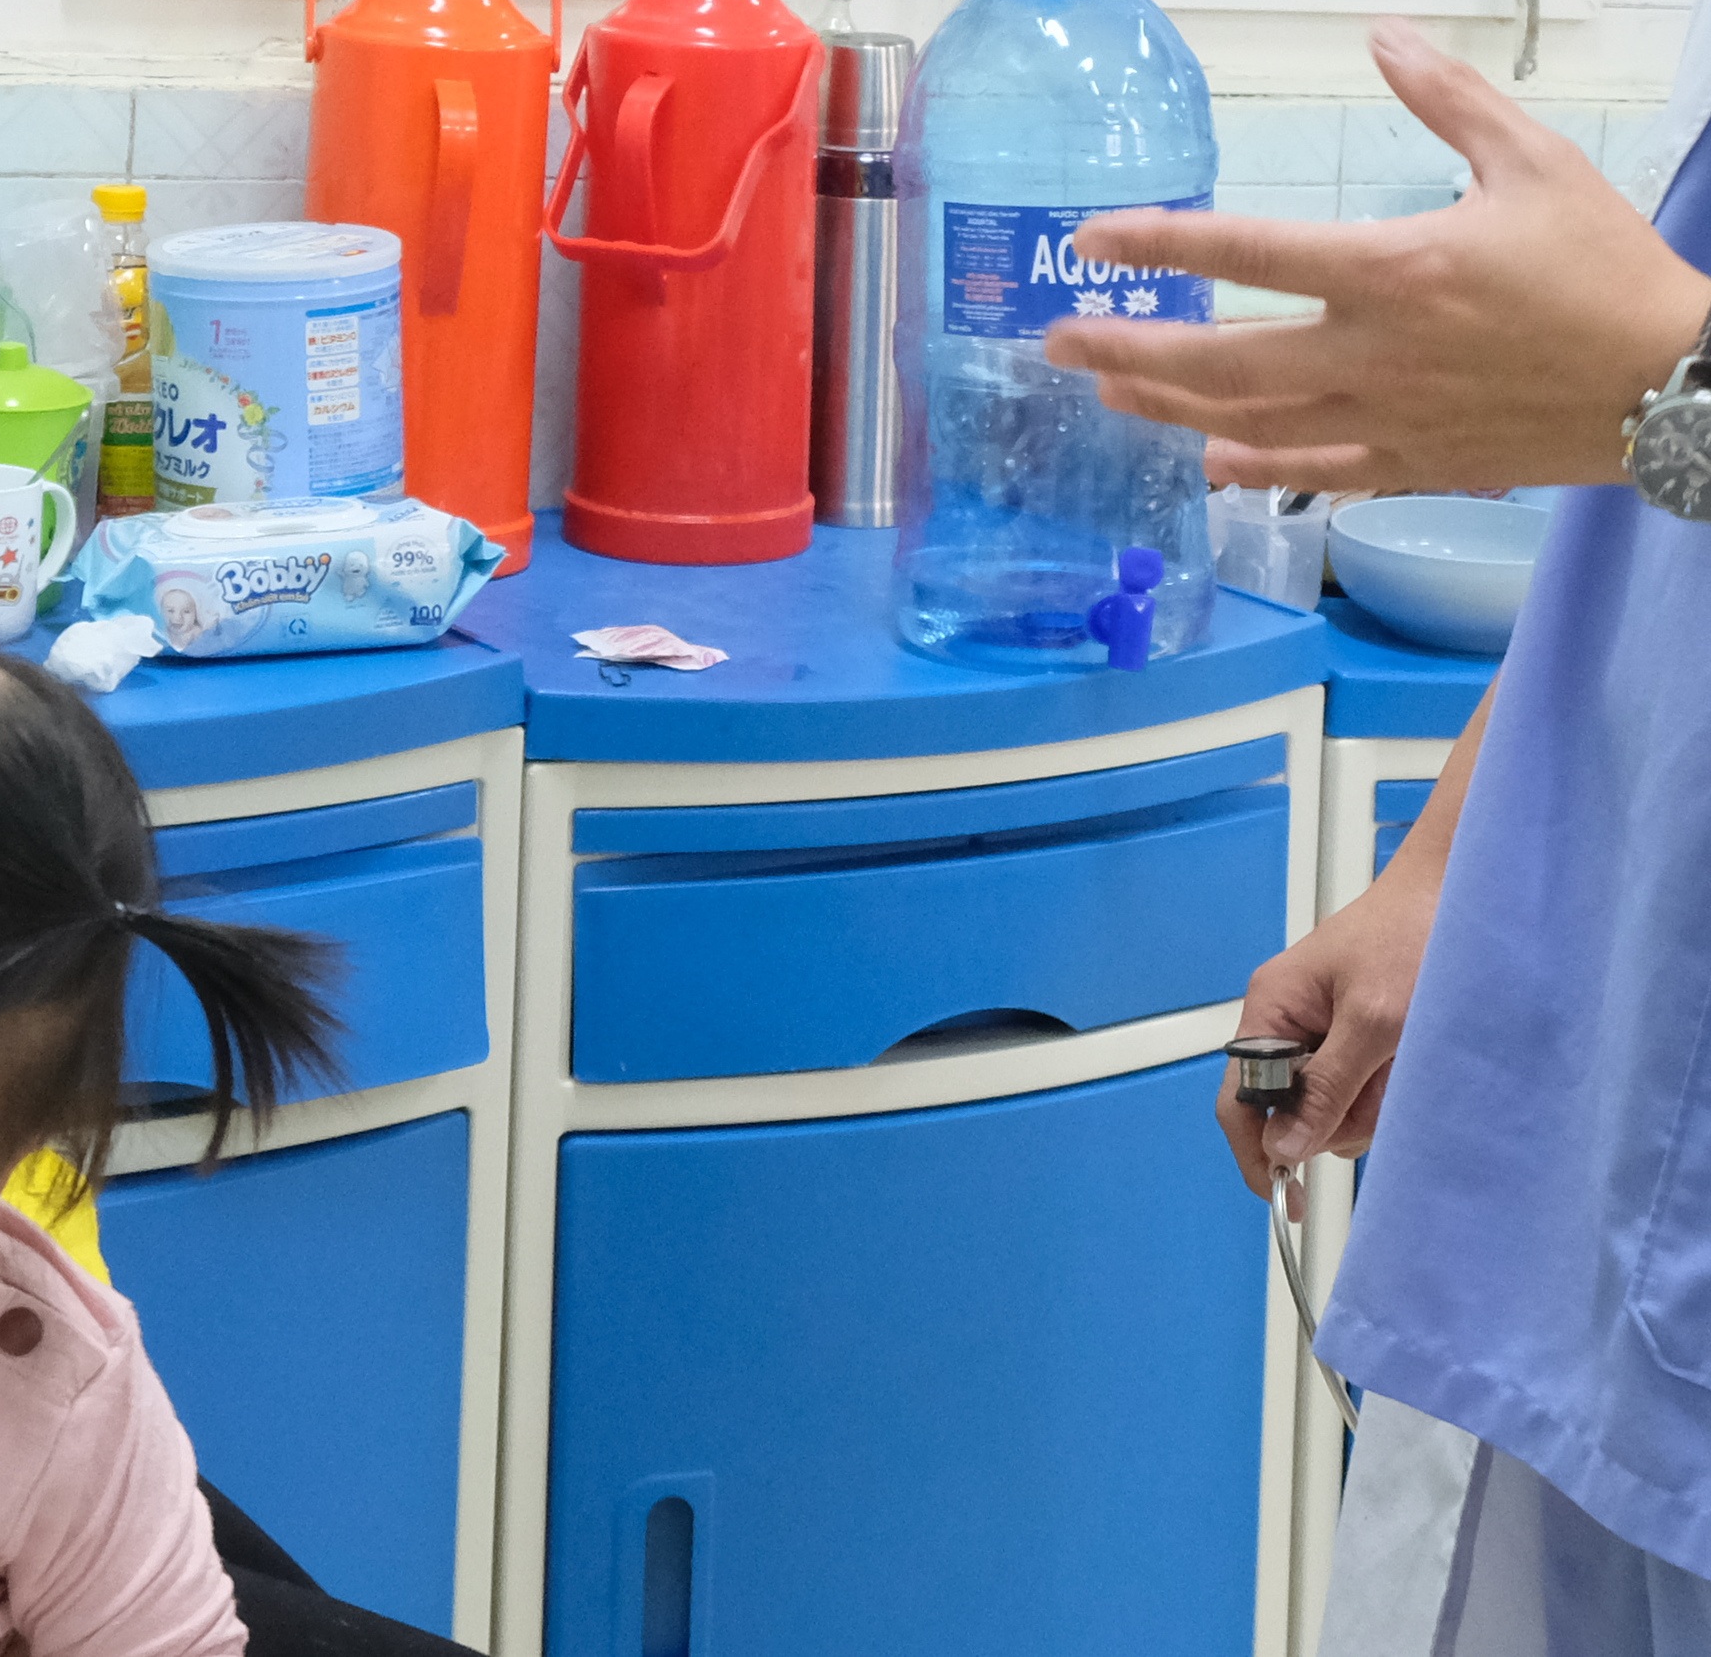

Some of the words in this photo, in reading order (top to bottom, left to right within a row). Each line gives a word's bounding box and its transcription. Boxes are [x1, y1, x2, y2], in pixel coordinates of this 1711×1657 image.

[392, 550, 434, 568] 99%
[216, 553, 332, 603] Bobby
[409, 603, 443, 624] 100
